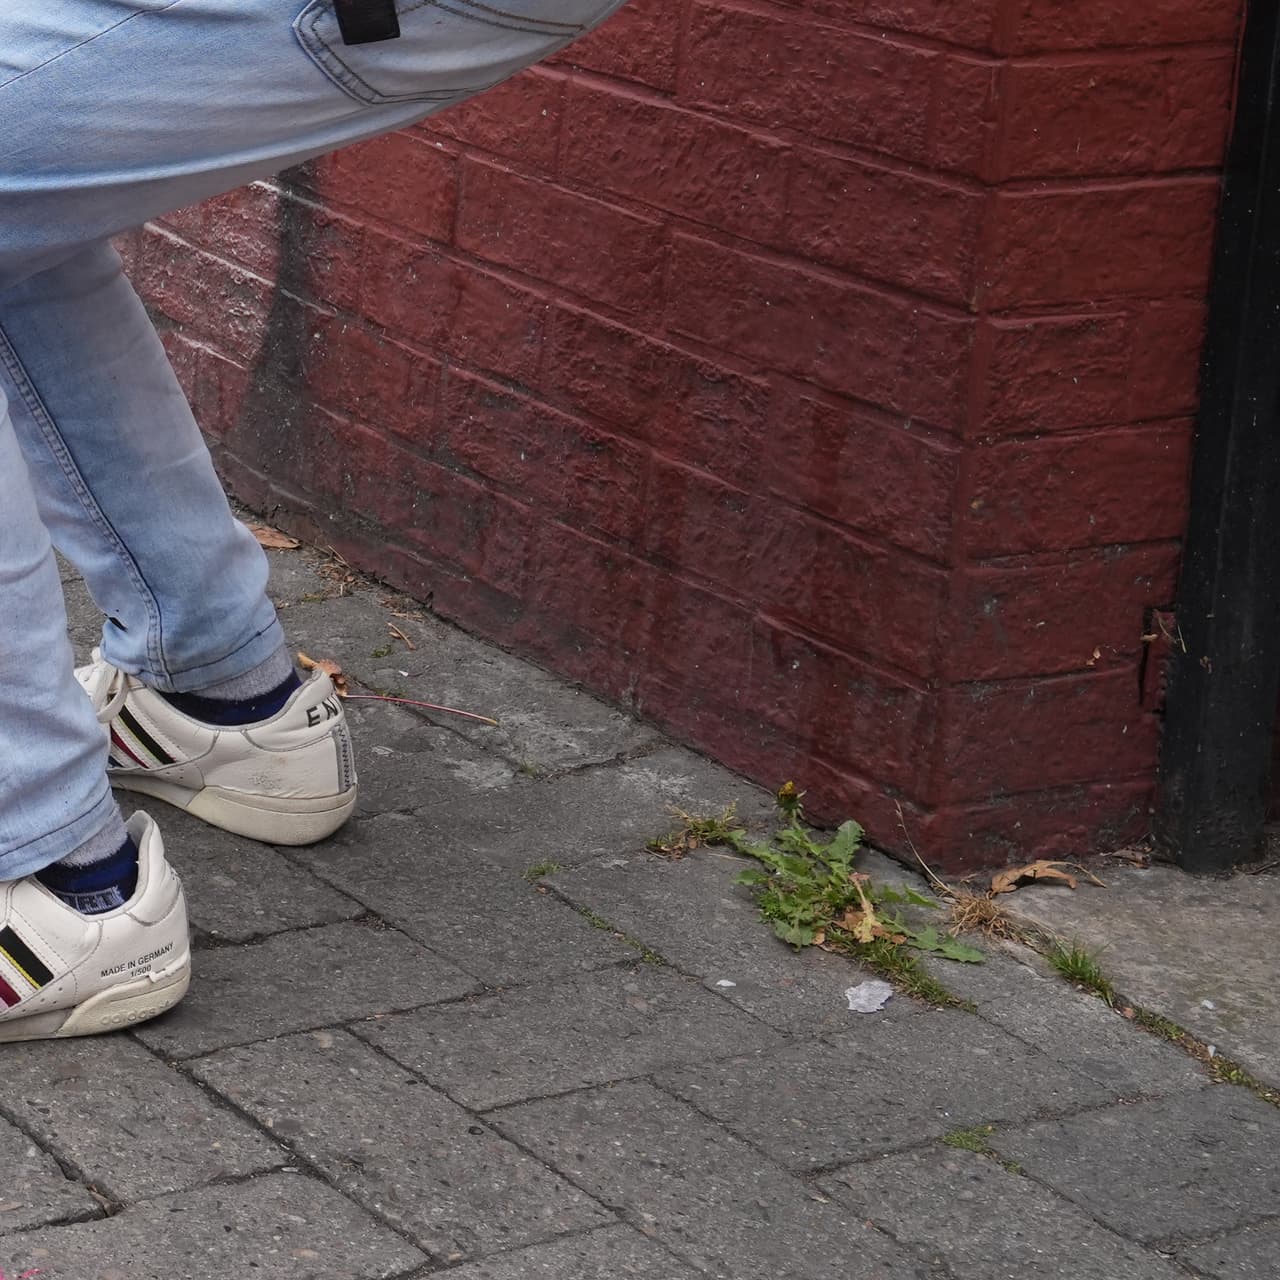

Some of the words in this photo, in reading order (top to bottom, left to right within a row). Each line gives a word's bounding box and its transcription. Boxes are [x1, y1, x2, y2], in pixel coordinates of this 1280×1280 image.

[306, 692, 344, 728] EN
[100, 963, 126, 977] MADE
[127, 959, 136, 970] IN
[139, 942, 174, 965] GERMANY
[131, 964, 151, 977] 1/500
